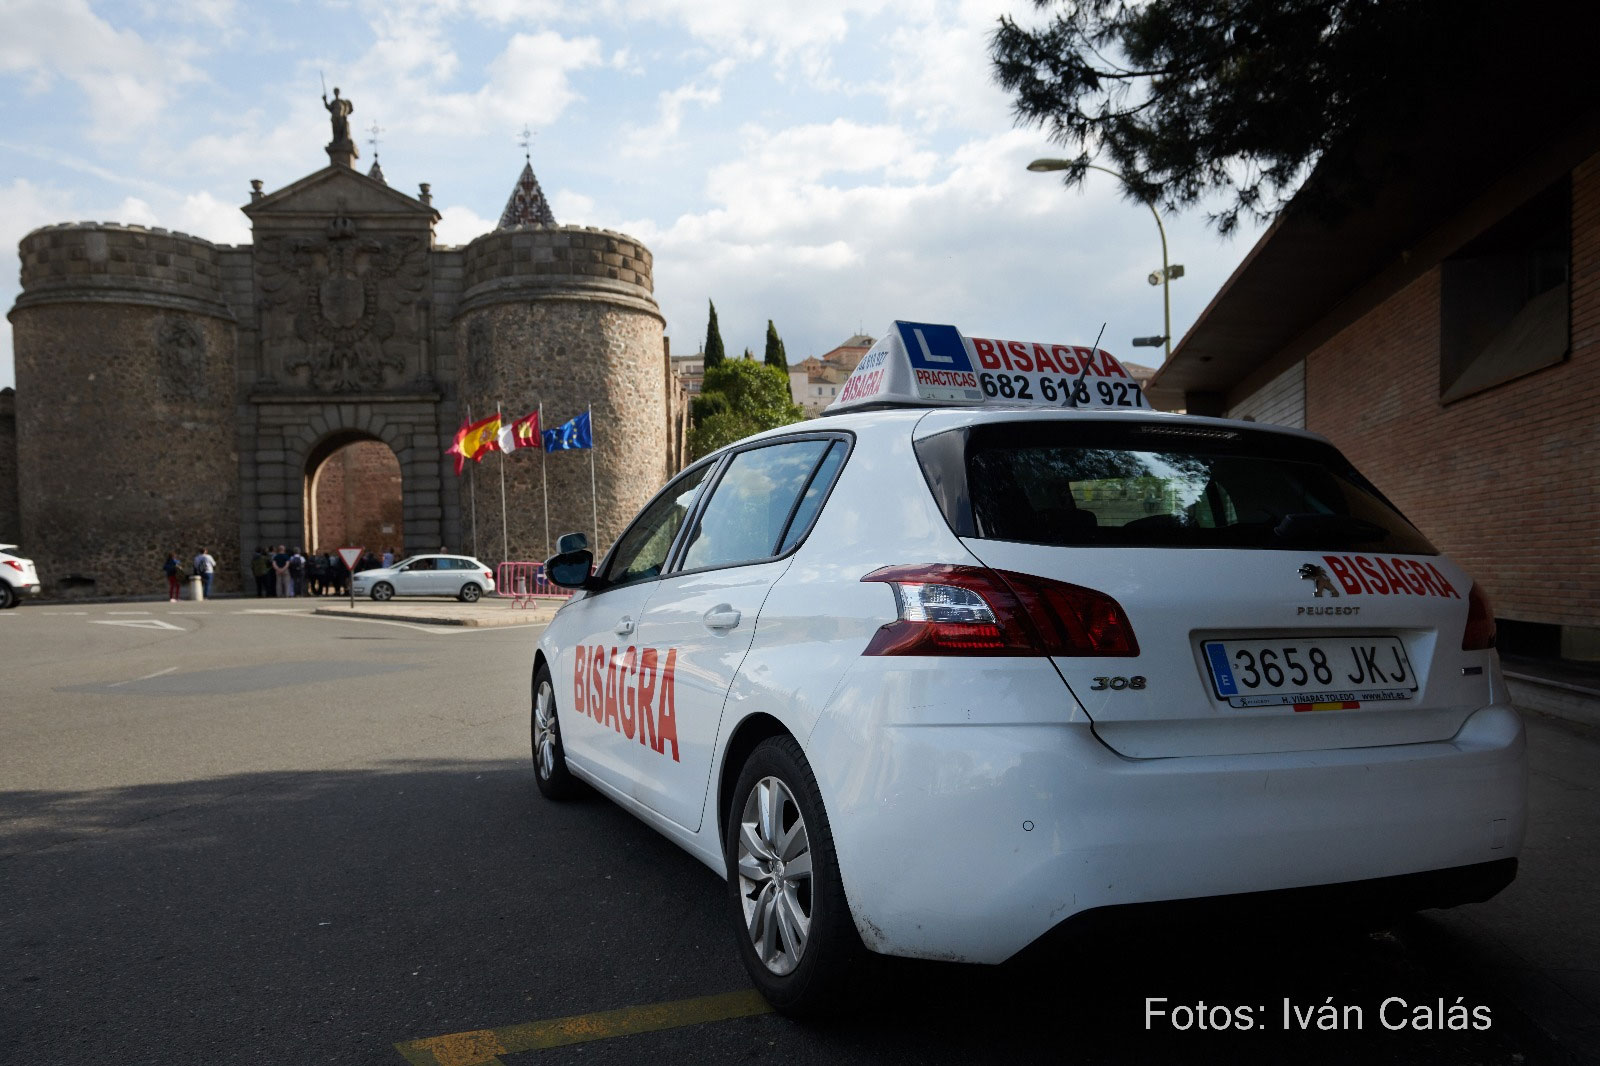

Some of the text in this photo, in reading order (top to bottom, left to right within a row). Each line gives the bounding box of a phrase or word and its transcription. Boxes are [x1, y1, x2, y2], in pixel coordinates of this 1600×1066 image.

[913, 328, 954, 363] L
[972, 337, 1127, 378] BISAGRA
[841, 369, 885, 402] BISAGRA
[916, 369, 977, 388] PRACTICAS
[979, 373, 1142, 407] 682 618 927
[1322, 555, 1462, 599] BISAGRA
[1297, 606, 1361, 616] PEUGEOT
[1090, 675, 1147, 691] 308
[1221, 674, 1231, 686] E
[1235, 646, 1406, 689] 3658 JKJ
[574, 645, 680, 763] BISAGRA
[1281, 696, 1291, 704] H.
[1325, 693, 1355, 702] TOLEDO
